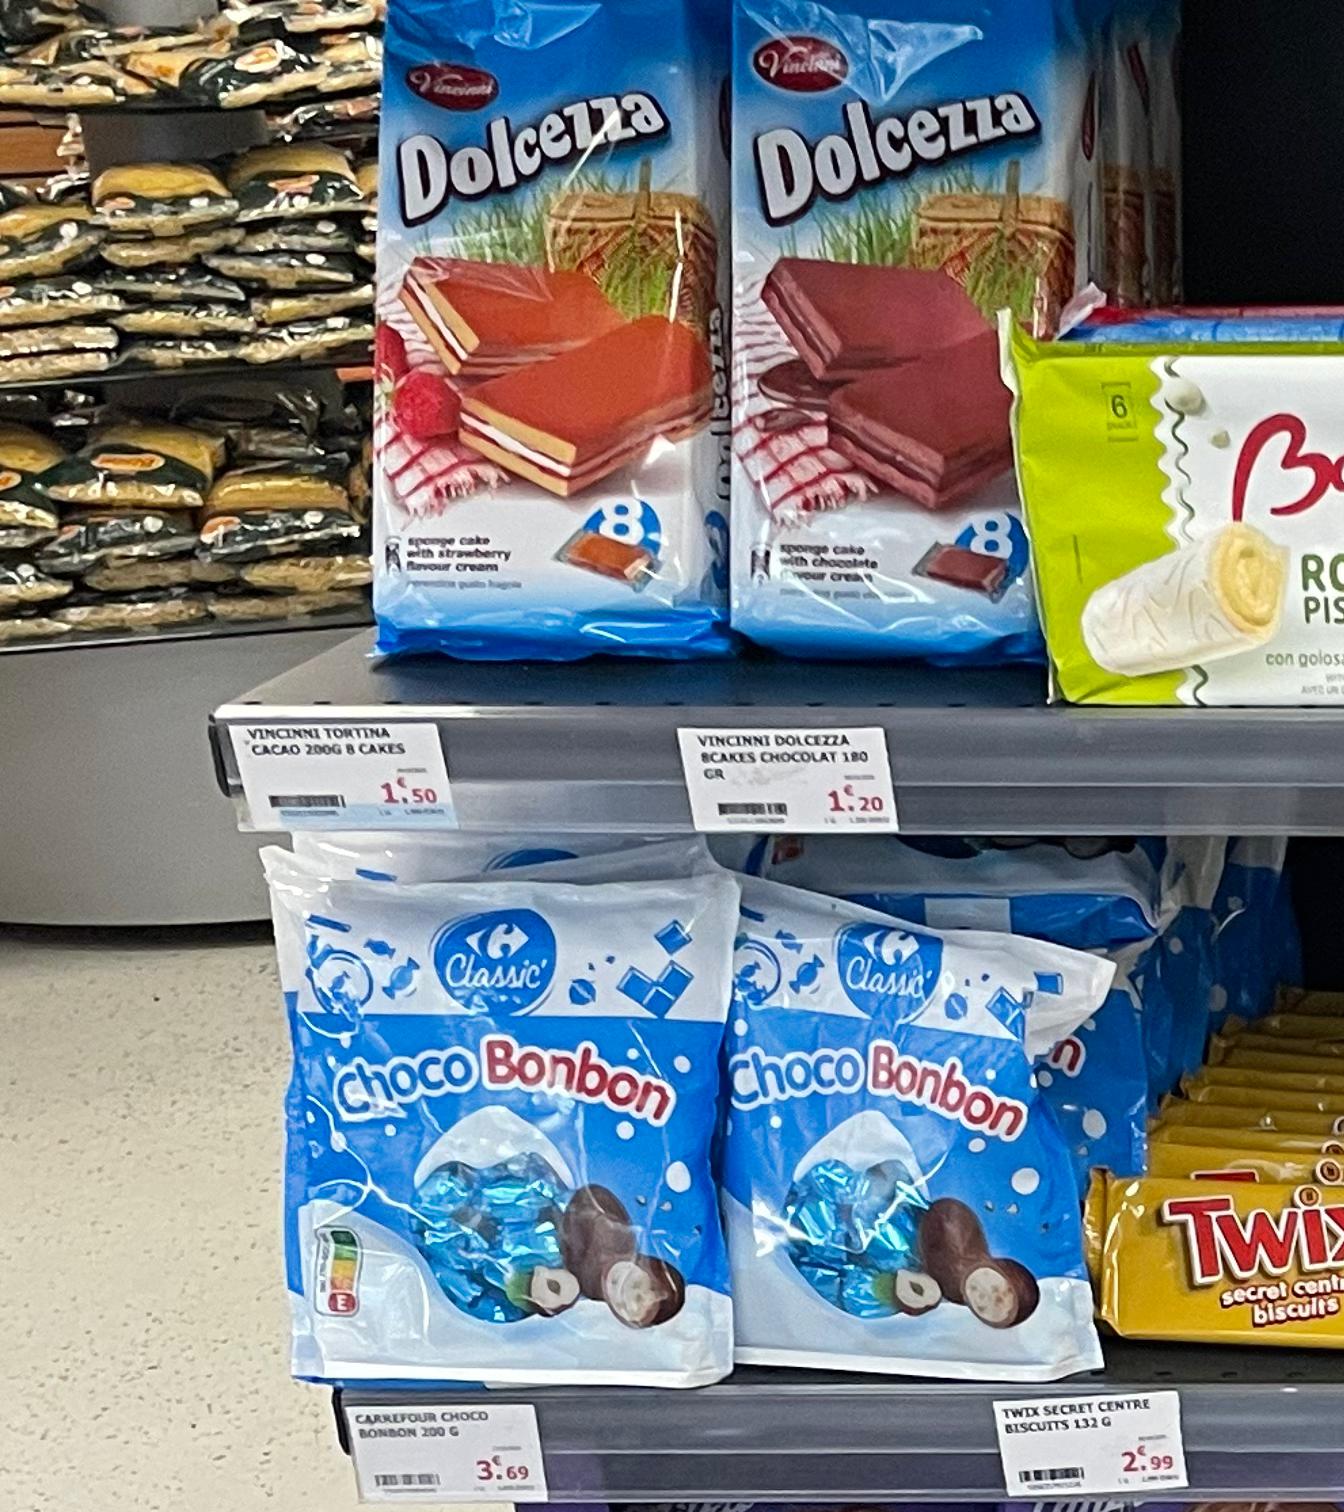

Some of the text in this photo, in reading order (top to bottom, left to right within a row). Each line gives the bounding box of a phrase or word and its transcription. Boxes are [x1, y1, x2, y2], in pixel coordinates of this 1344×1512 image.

[400, 92, 668, 225] Dolcezza
[755, 92, 1039, 225] Dolcezza
[438, 548, 511, 562] strawberry
[1265, 652, 1294, 666] con
[247, 728, 390, 739] VINCINNI TORTINA
[698, 735, 849, 746] VINCINNI DOLCEZZA
[252, 744, 300, 755] CACAO
[306, 744, 341, 755] 200G
[359, 743, 406, 754] CAKES
[701, 752, 837, 763] 8CAKES CHOCOLAT
[445, 955, 546, 992] Classic
[846, 956, 933, 1001] Classic
[336, 1034, 676, 1126] Choco Bonbon
[731, 1041, 1028, 1139] Choco Bonbon
[1221, 1280, 1291, 1306] secret
[1251, 1297, 1339, 1325] biscuits
[355, 1410, 489, 1425] CARREFOUR CHOCO
[1004, 1399, 1150, 1420] TWIX SECRET CENTRE
[359, 1427, 417, 1439] BONBON
[1005, 1417, 1098, 1434] BISCUITS 132
